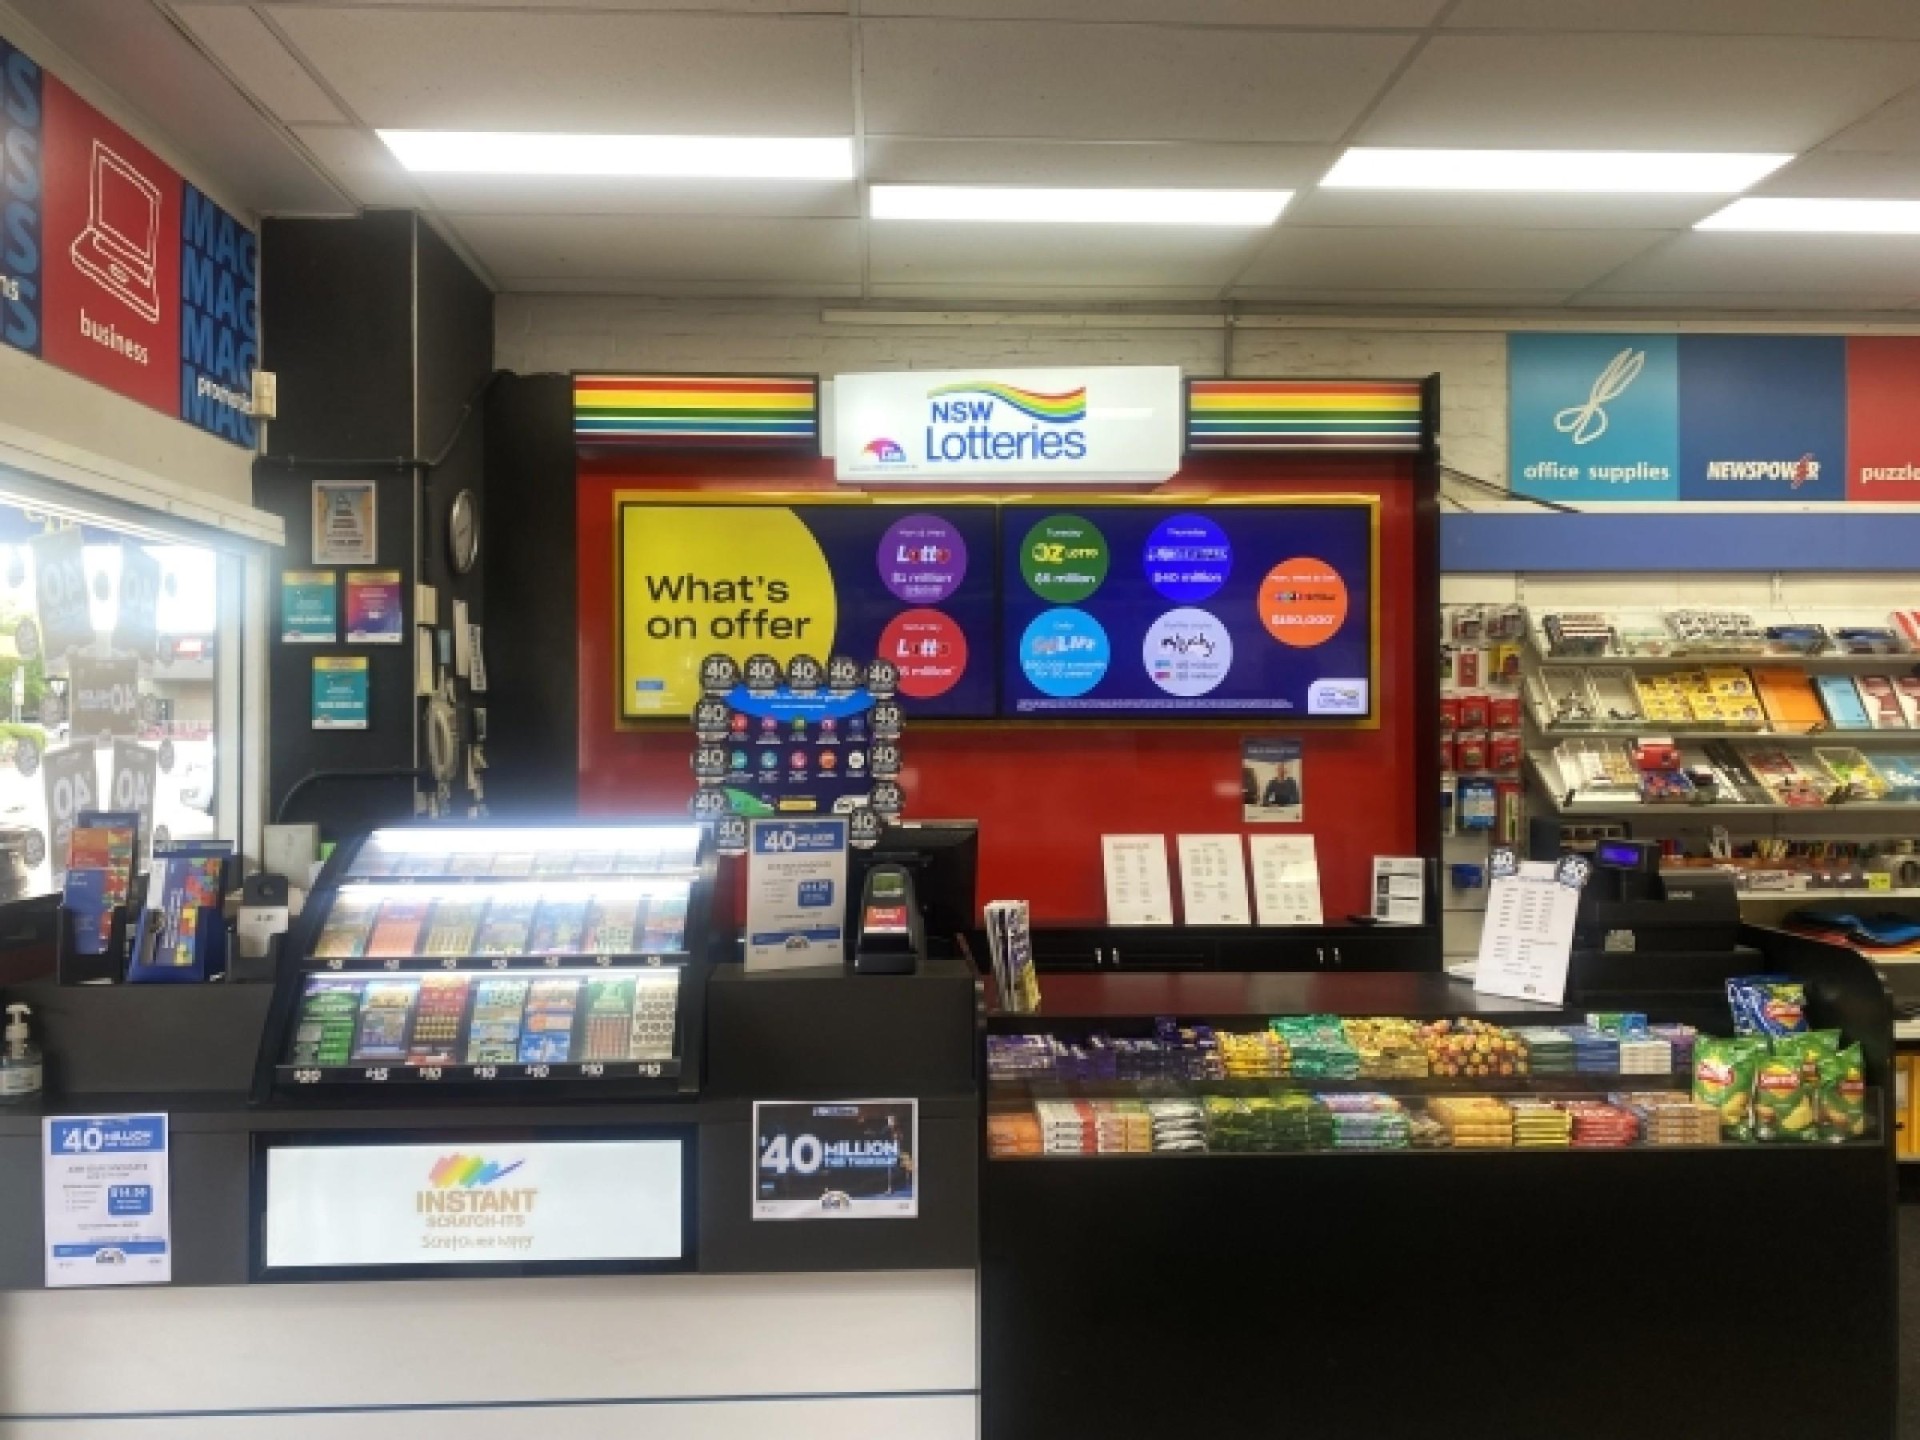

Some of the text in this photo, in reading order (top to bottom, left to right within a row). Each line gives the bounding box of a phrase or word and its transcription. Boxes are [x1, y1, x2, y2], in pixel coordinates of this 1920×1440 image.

[80, 308, 149, 365] business
[932, 402, 993, 424] NSW
[926, 426, 1087, 462] Lotteries
[1523, 462, 1670, 484] office supplies
[896, 545, 951, 565] Lotto
[646, 576, 789, 603] What's
[646, 608, 812, 641] on offer
[824, 1139, 898, 1156] MILLION
[416, 1189, 538, 1213] INSTANT
[425, 1215, 525, 1228] SCRATCH-ITS
